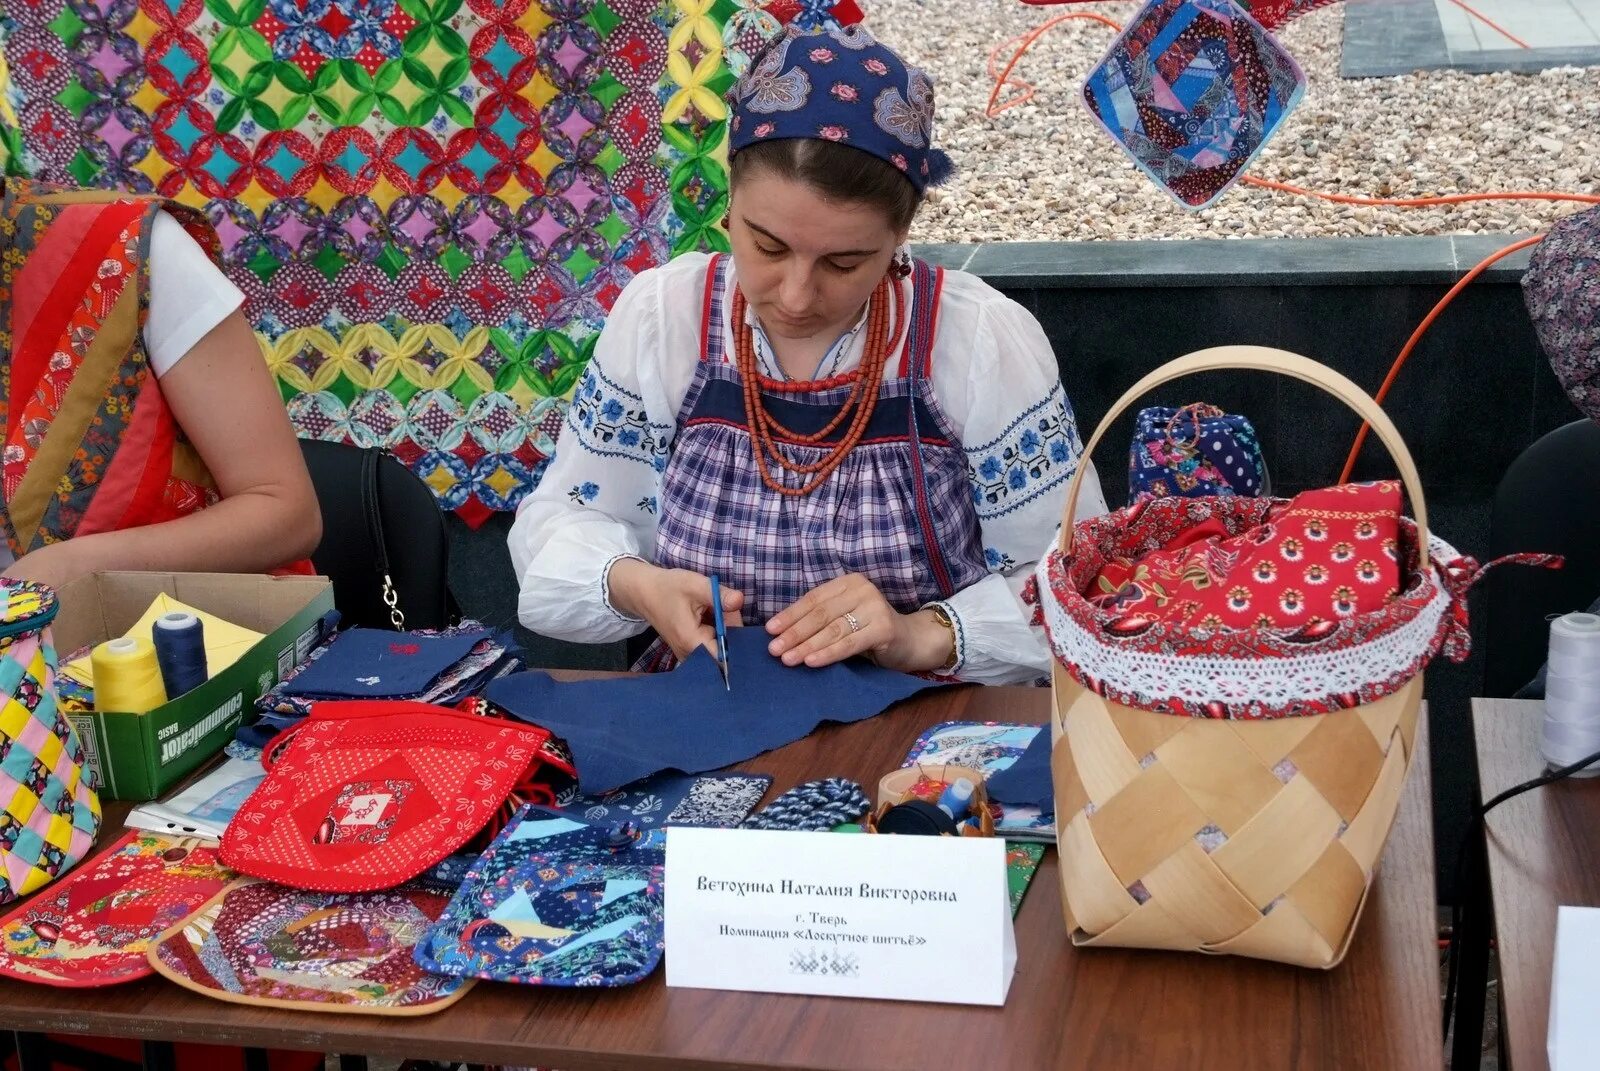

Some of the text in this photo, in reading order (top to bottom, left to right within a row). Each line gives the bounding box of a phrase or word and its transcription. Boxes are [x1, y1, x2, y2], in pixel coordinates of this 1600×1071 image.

[157, 722, 179, 740] BASIC
[697, 875, 958, 904] Ветохина Наталия Викторовна
[795, 911, 848, 927] г. Тверь
[719, 924, 927, 946] Номинация «Лоскутное шитьё»
